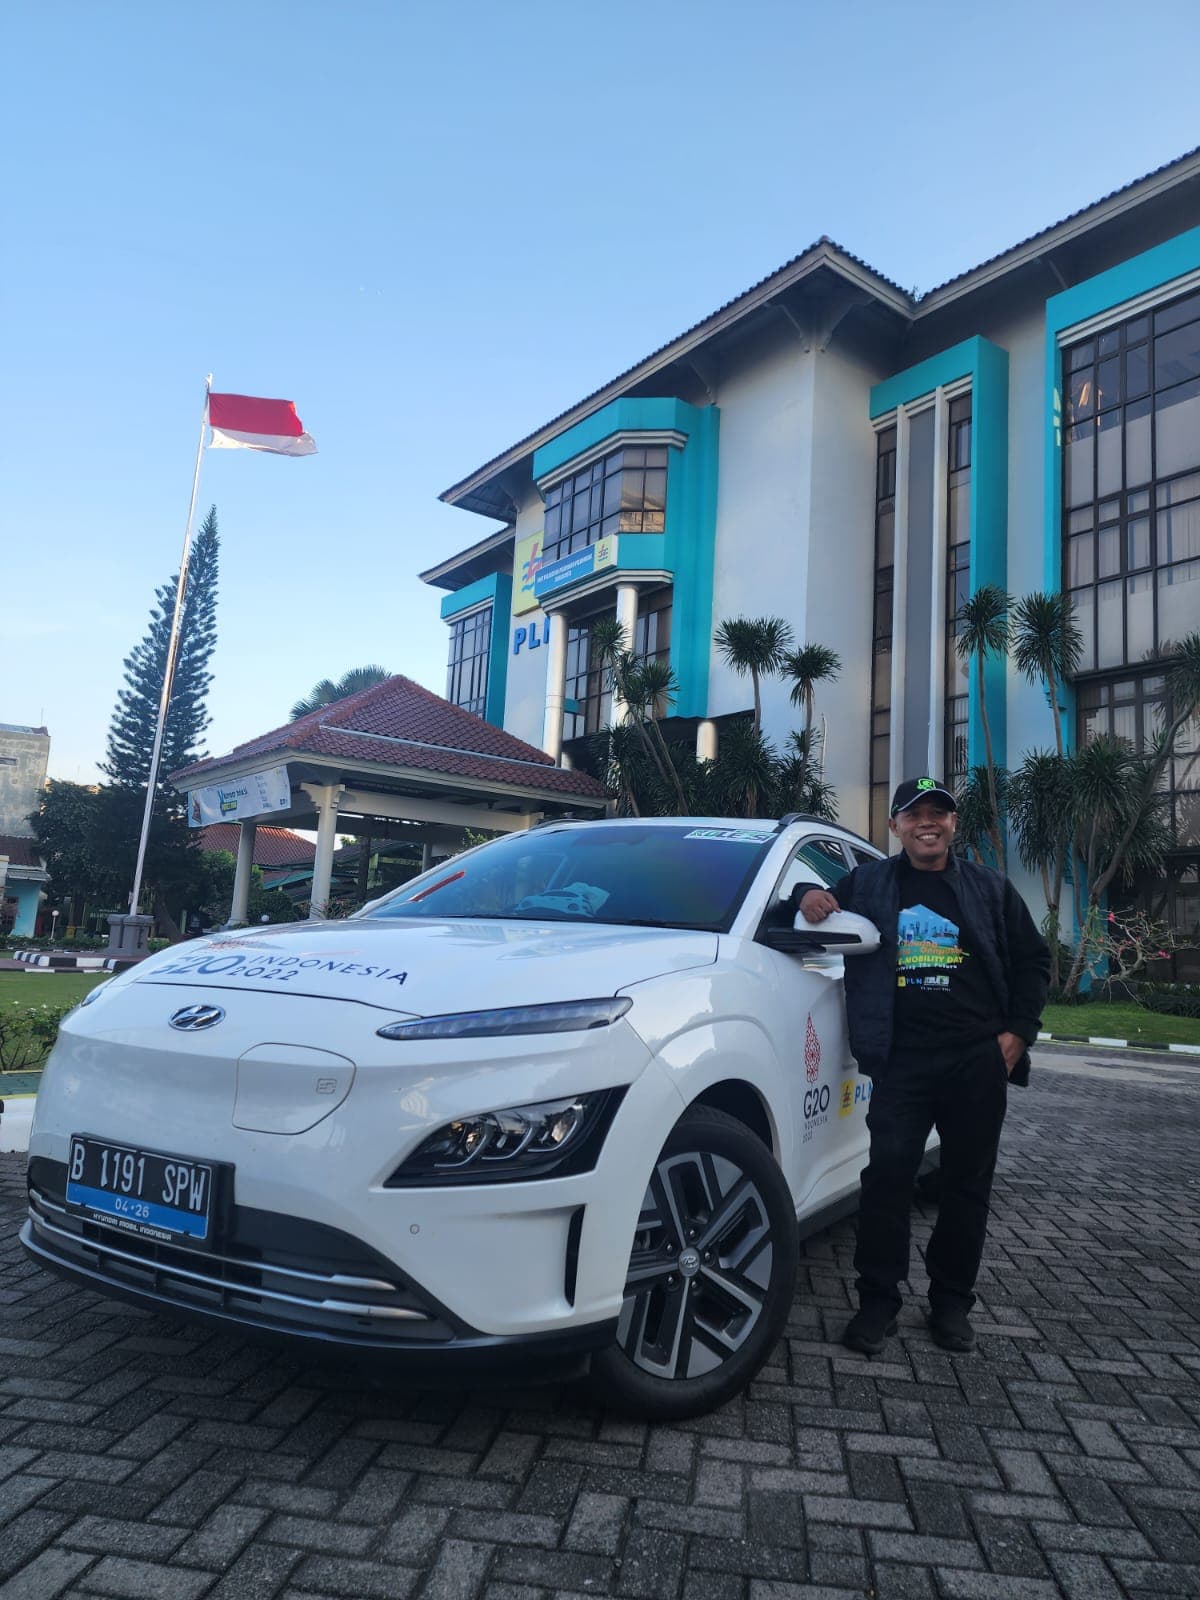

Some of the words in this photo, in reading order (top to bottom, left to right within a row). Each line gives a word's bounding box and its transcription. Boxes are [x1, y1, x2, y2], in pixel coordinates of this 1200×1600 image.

[228, 966, 299, 981] 2022
[247, 955, 408, 985] INDONESIA
[946, 956, 963, 964] DAY
[803, 1084, 830, 1119] G20
[70, 1143, 86, 1181] B
[100, 1149, 146, 1196] 1191
[162, 1163, 206, 1212] SPW
